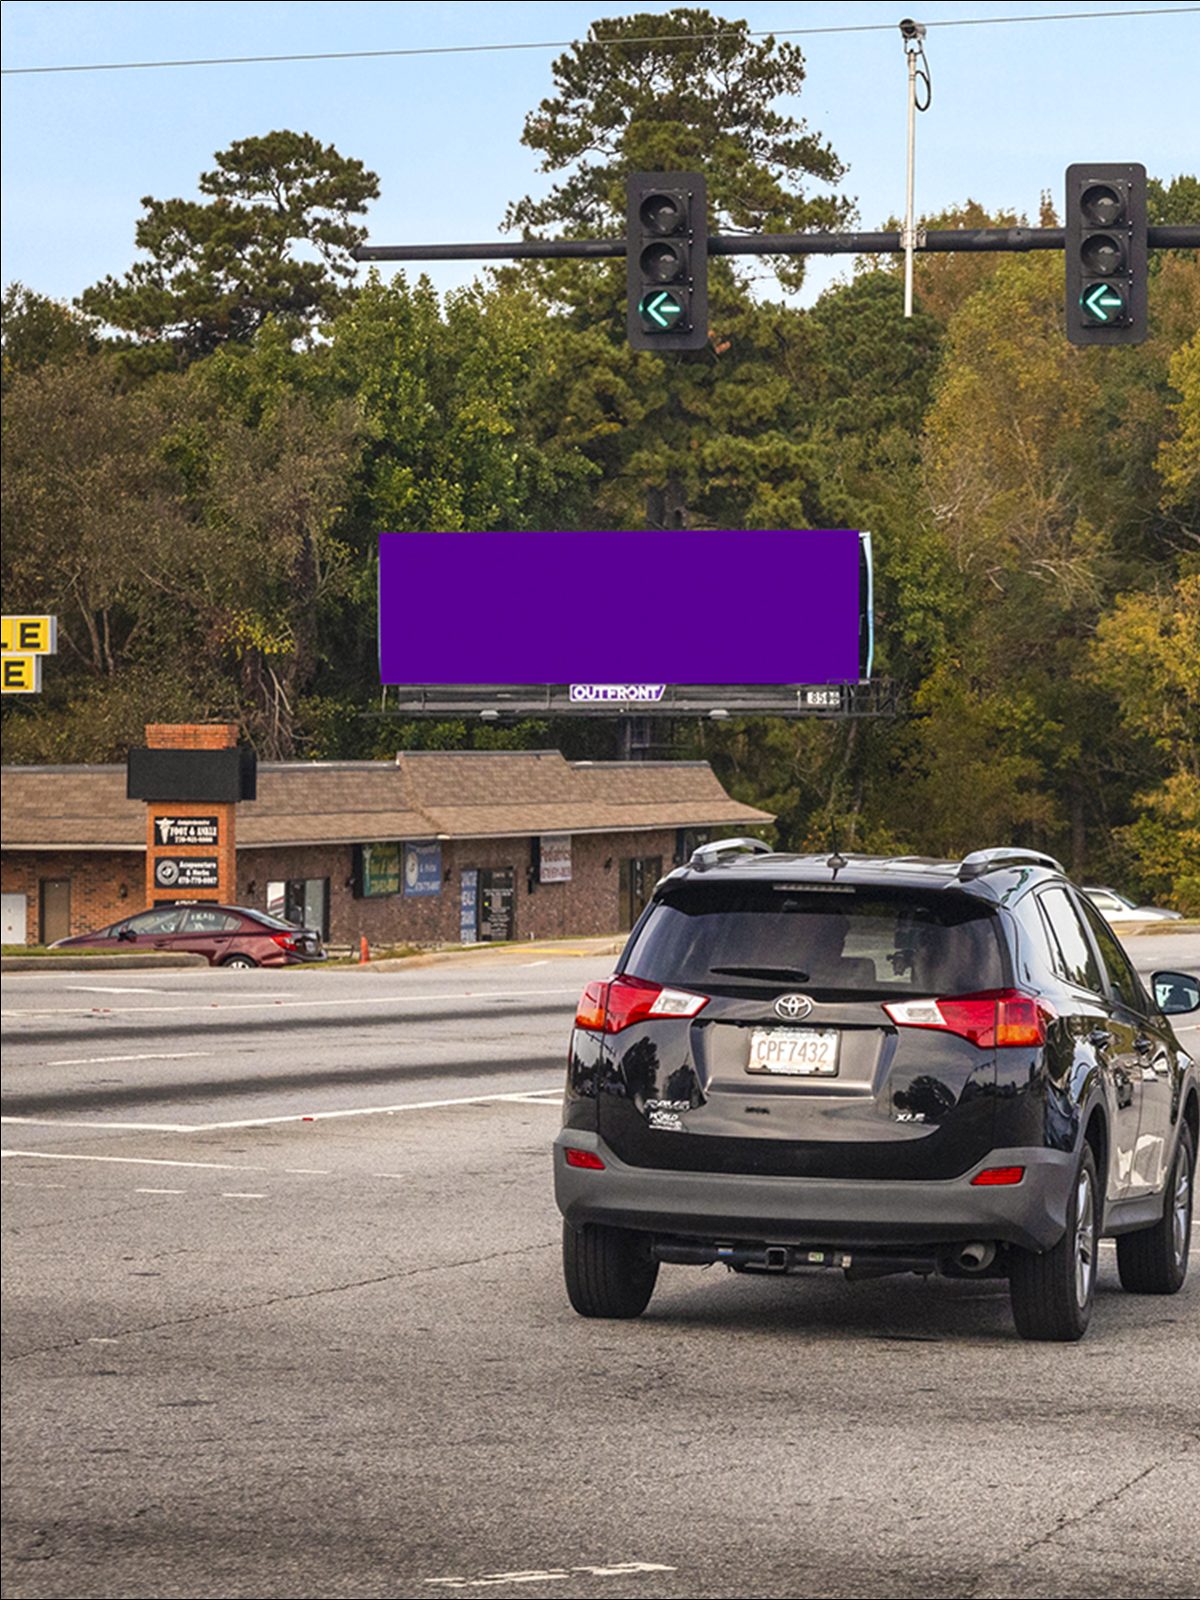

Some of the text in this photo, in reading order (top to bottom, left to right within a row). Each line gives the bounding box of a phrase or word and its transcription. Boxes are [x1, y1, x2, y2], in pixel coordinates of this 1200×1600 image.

[572, 685, 660, 700] OUTFRONT
[170, 826, 217, 837] FOOT & ANKLE
[757, 1040, 829, 1064] CPF7432
